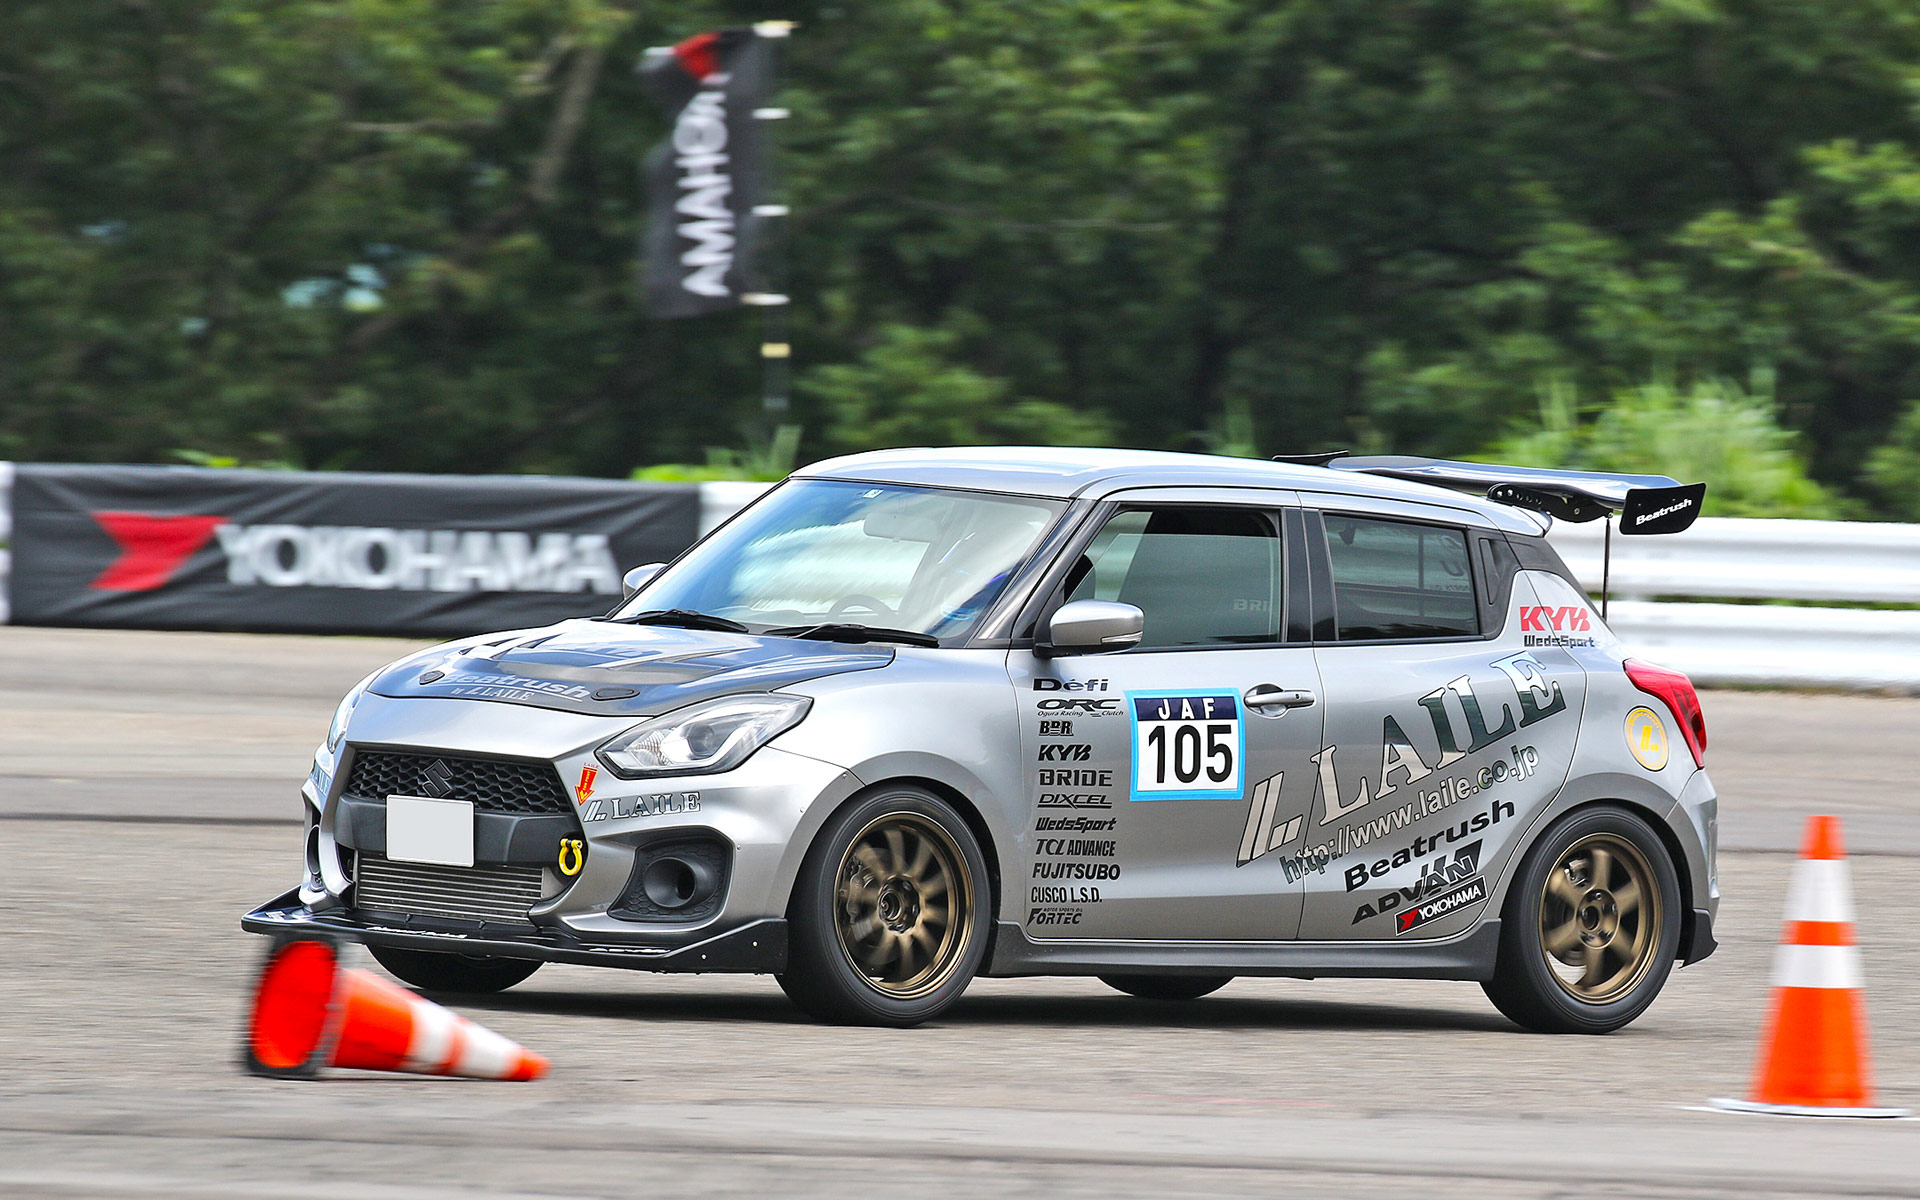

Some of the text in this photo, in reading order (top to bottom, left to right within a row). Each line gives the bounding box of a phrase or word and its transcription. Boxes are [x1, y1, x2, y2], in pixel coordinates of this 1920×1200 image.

[1636, 499, 1692, 525] Beatrush
[214, 522, 621, 595] YOKOHAMA
[1520, 606, 1591, 632] KYB
[1524, 634, 1595, 648] WedsSport
[480, 687, 536, 701] LAILE
[1037, 698, 1121, 712] ORC
[1310, 650, 1567, 827] LAILE
[1038, 744, 1092, 761] KYB
[1148, 724, 1233, 784] 105
[1039, 768, 1113, 787] BRIDE
[611, 791, 701, 819] LAILE
[1038, 794, 1113, 806] DIXCEL
[1280, 744, 1540, 883] http://www.laile.co.jp
[1035, 817, 1118, 833] WedsSport
[1035, 839, 1116, 857] TCL ADVANCE
[1344, 799, 1516, 893] Beatrush
[1032, 863, 1121, 880] FUJITSUBO
[1352, 843, 1480, 925] ADVAN
[1031, 886, 1102, 903] CUSCO L.S.D.
[1418, 884, 1482, 920] YOKOHAMA
[1026, 908, 1082, 927] FORTEC
